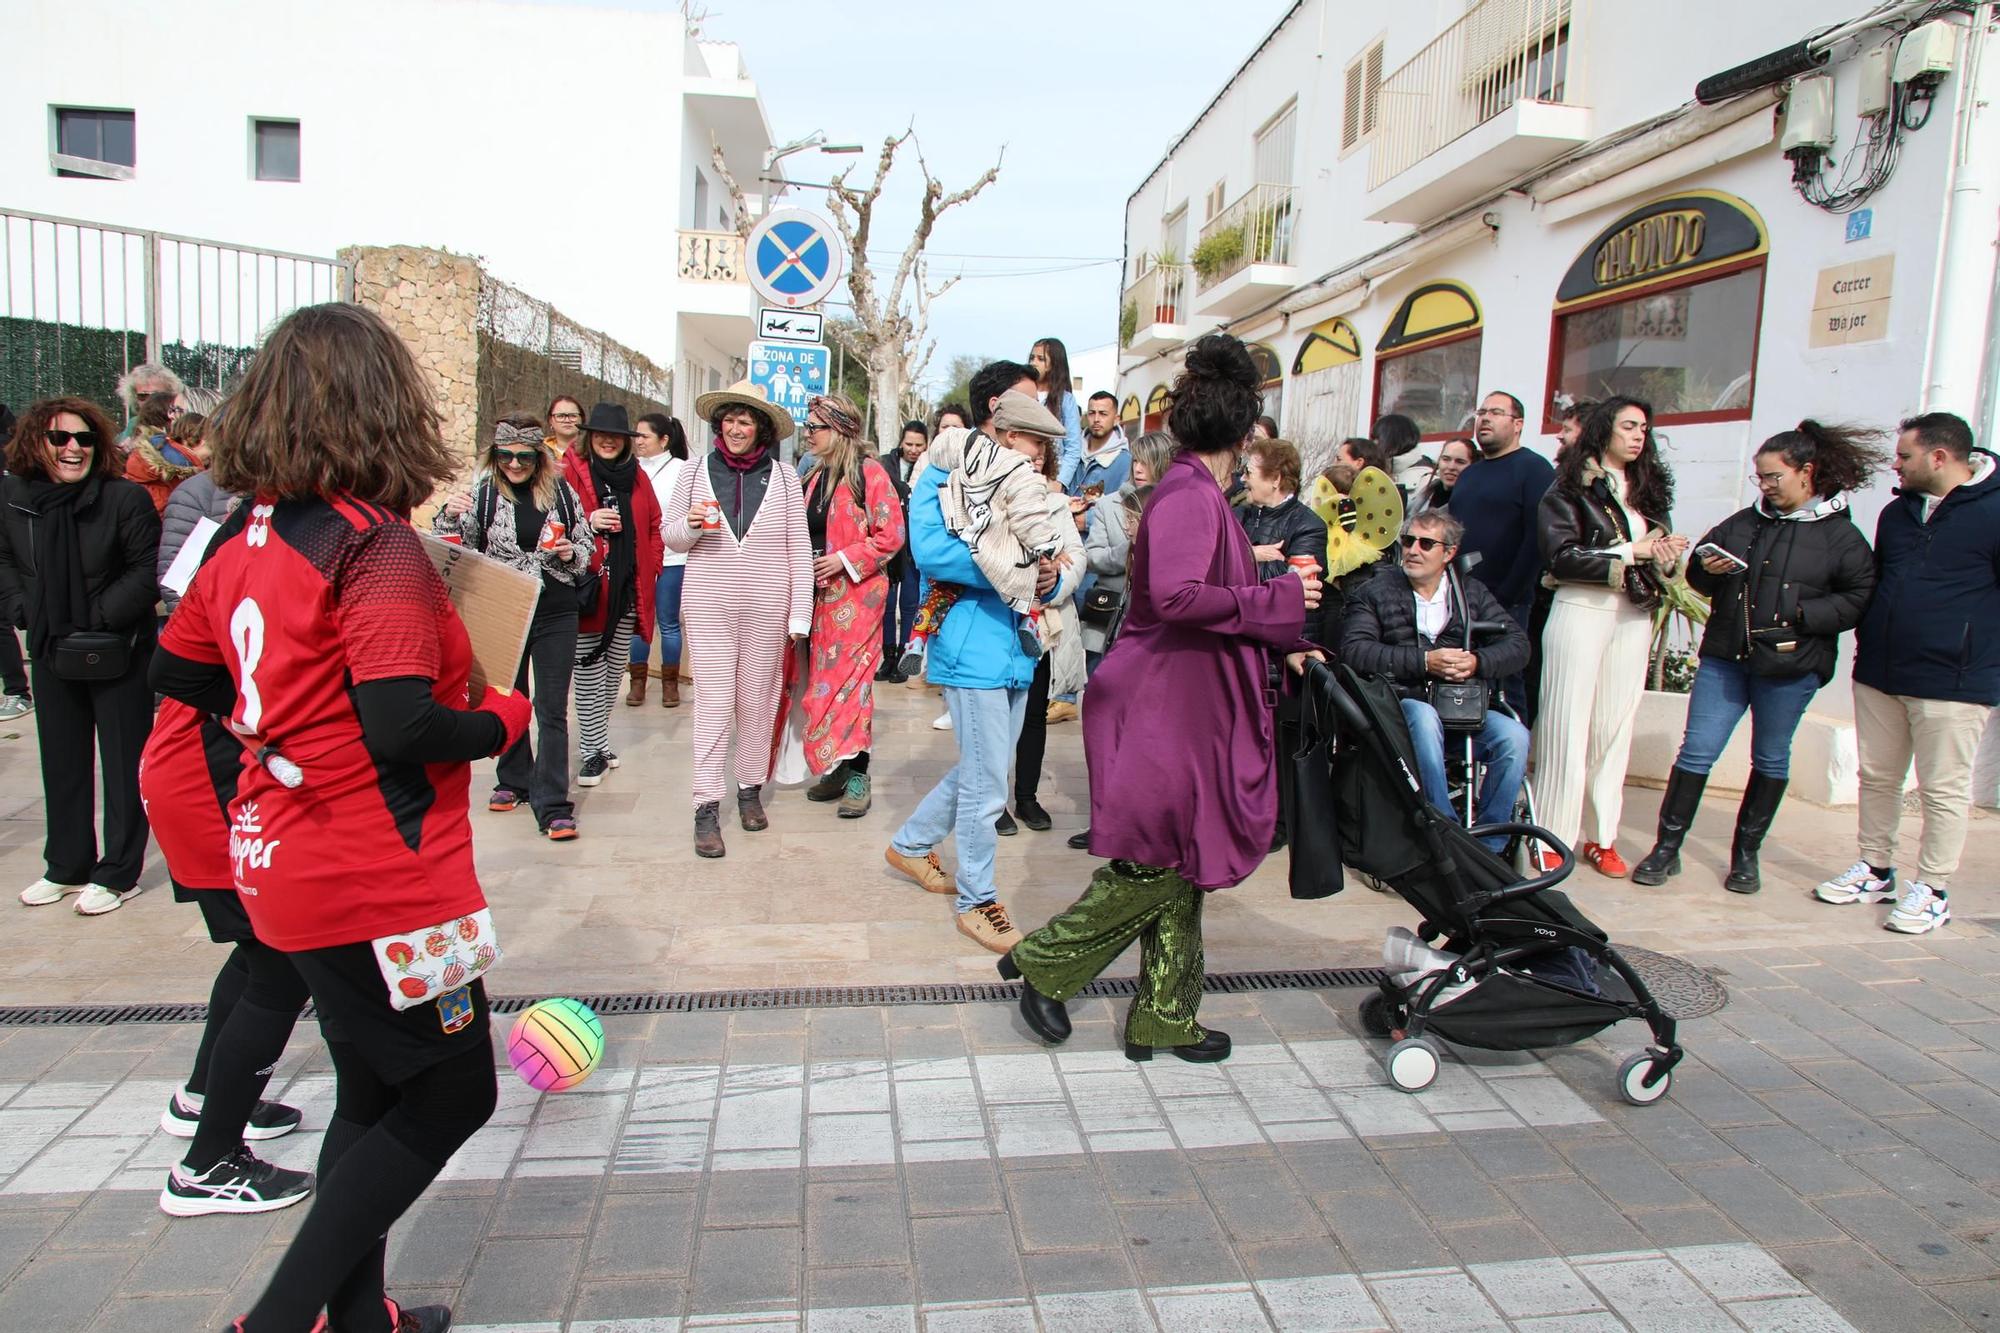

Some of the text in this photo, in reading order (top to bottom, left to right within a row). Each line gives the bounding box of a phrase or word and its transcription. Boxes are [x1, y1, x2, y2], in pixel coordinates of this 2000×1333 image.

[1850, 221, 1867, 238] 67
[1594, 212, 1706, 285] MACONDO
[1832, 277, 1871, 294] Carrer
[764, 350, 815, 364] ZONA DE
